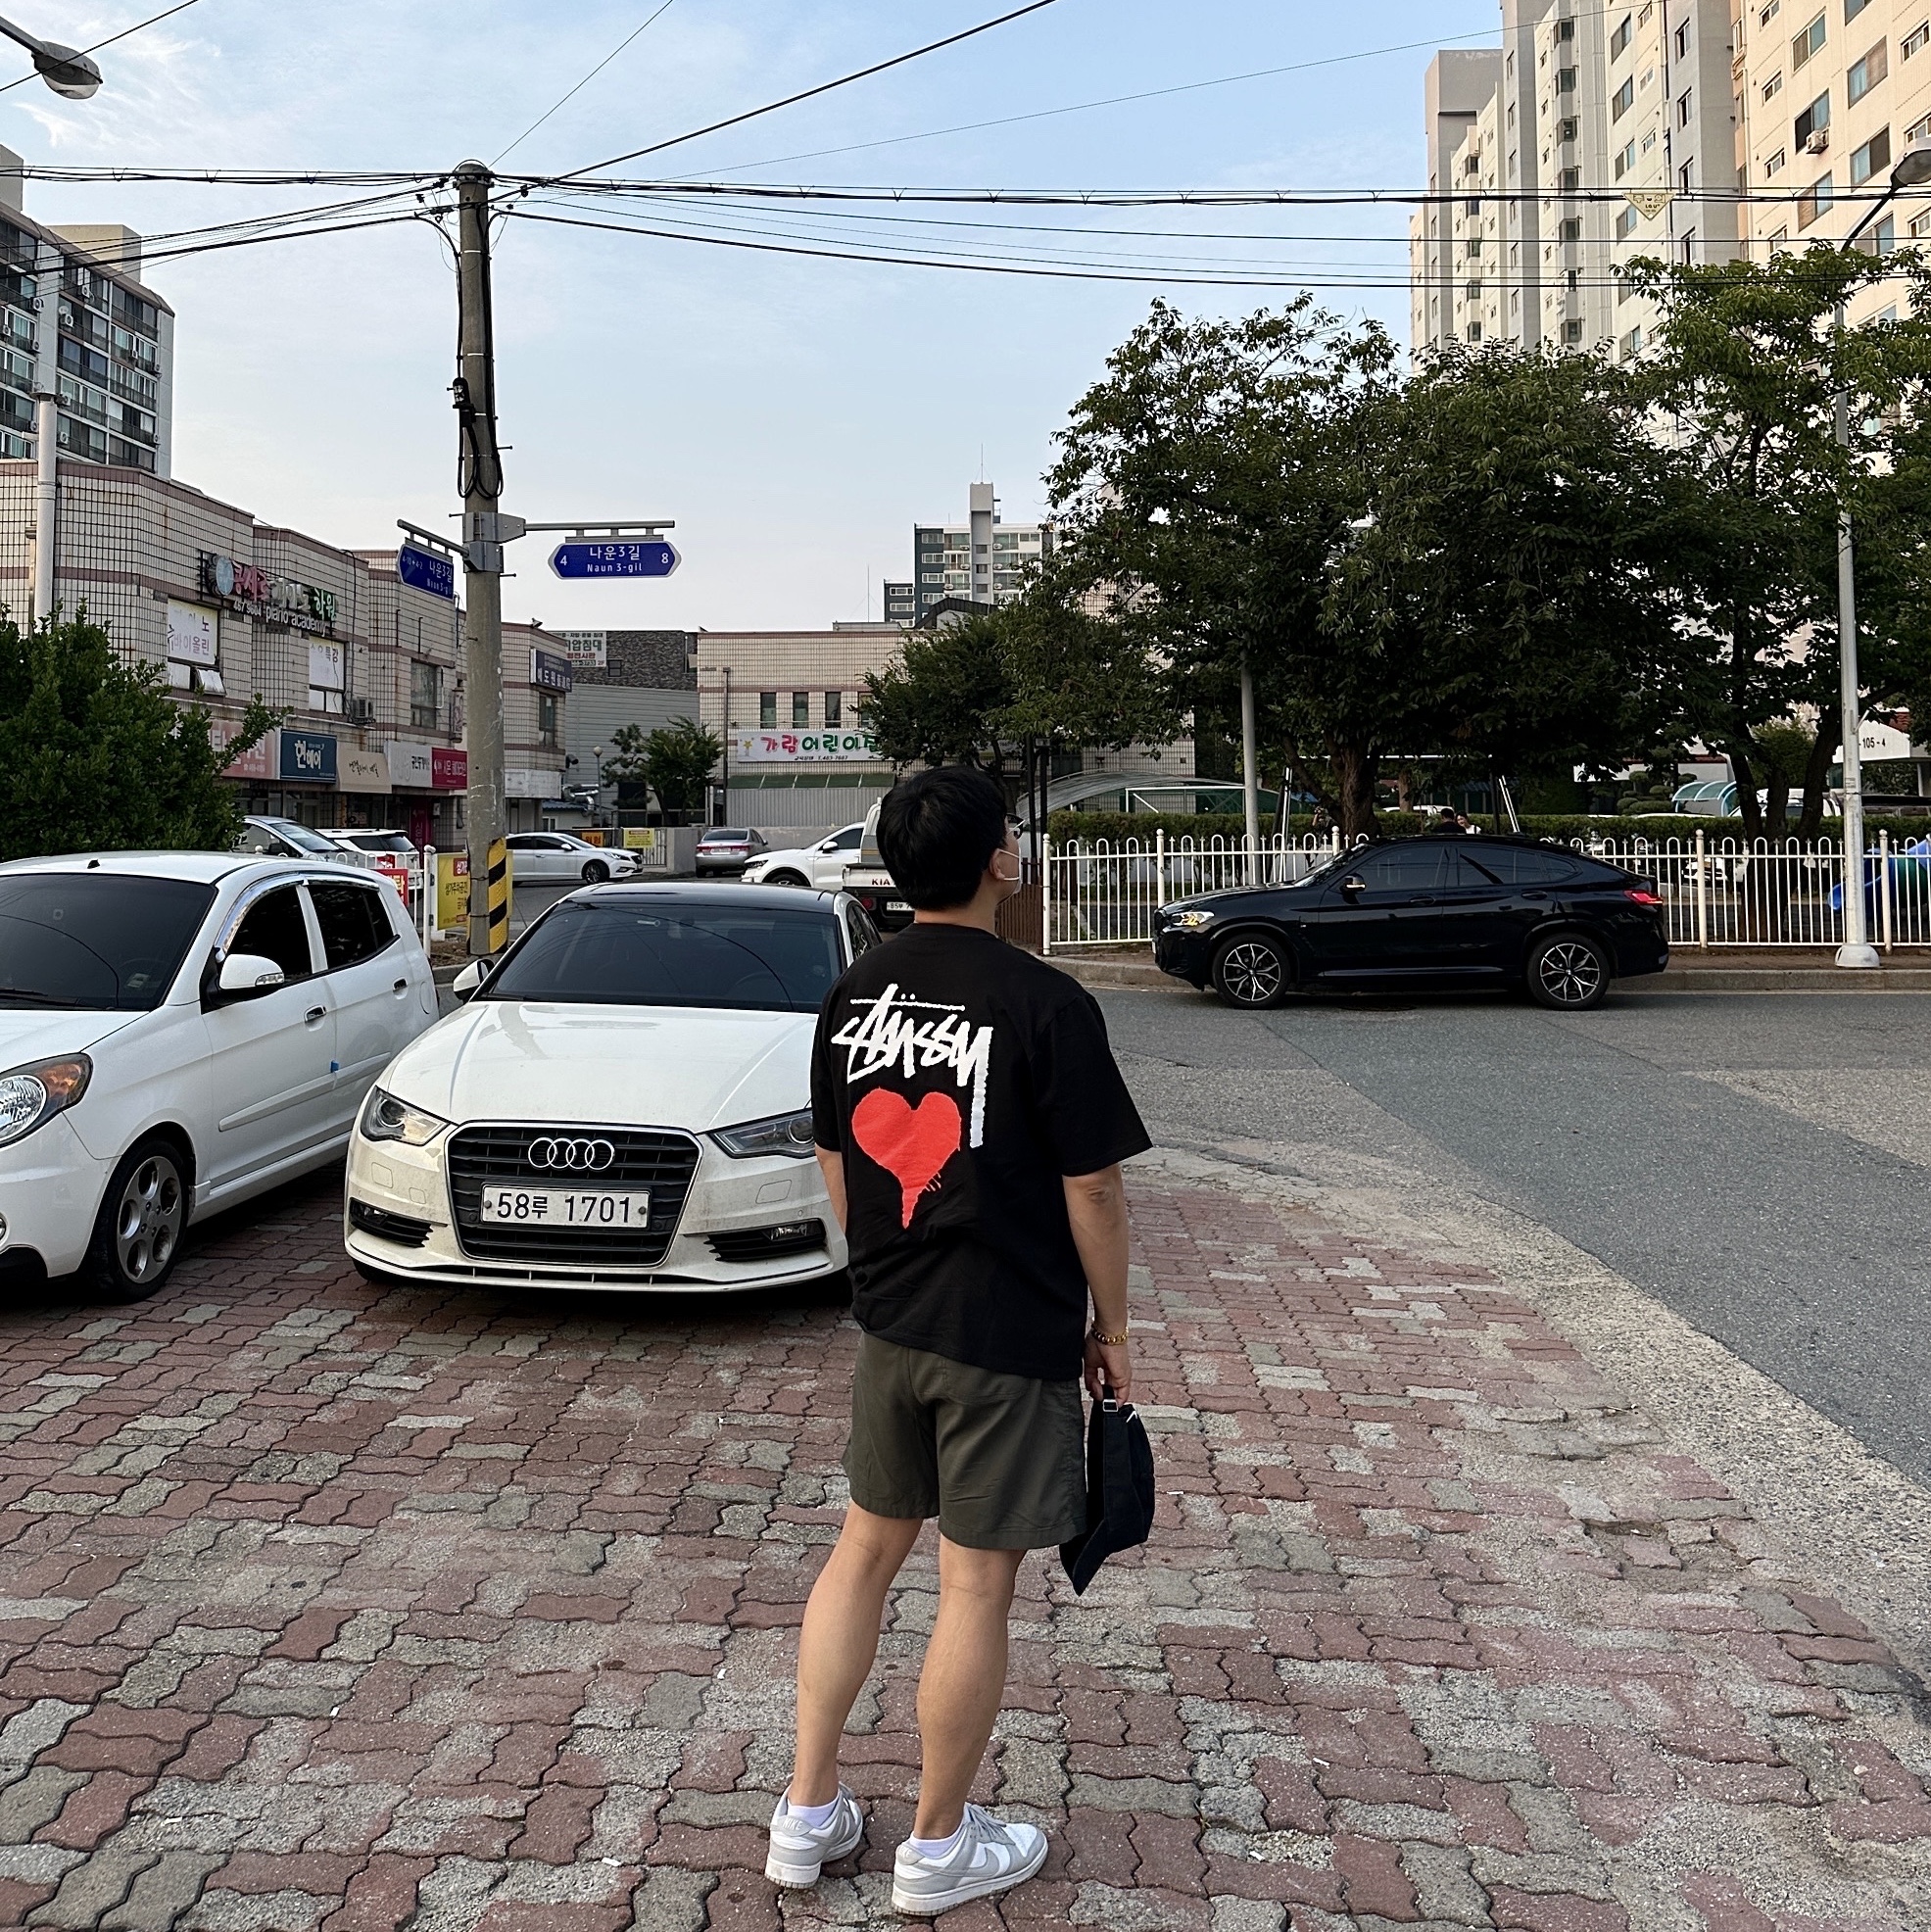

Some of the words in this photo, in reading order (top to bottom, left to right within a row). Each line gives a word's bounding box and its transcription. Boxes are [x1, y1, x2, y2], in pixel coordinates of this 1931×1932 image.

[560, 555, 568, 566] 4
[590, 545, 640, 560] 나운3길
[661, 553, 669, 564] 8
[429, 559, 453, 583] 나운3길
[587, 563, 613, 573] Naun
[616, 562, 642, 573] 3-gil
[314, 588, 337, 628] 학원
[266, 605, 289, 624] piano
[291, 613, 326, 638] academy
[173, 633, 210, 656] 바이올린
[497, 1192, 548, 1219] 58루
[564, 1195, 630, 1224] 1701
[782, 1817, 803, 1831] NIKE
